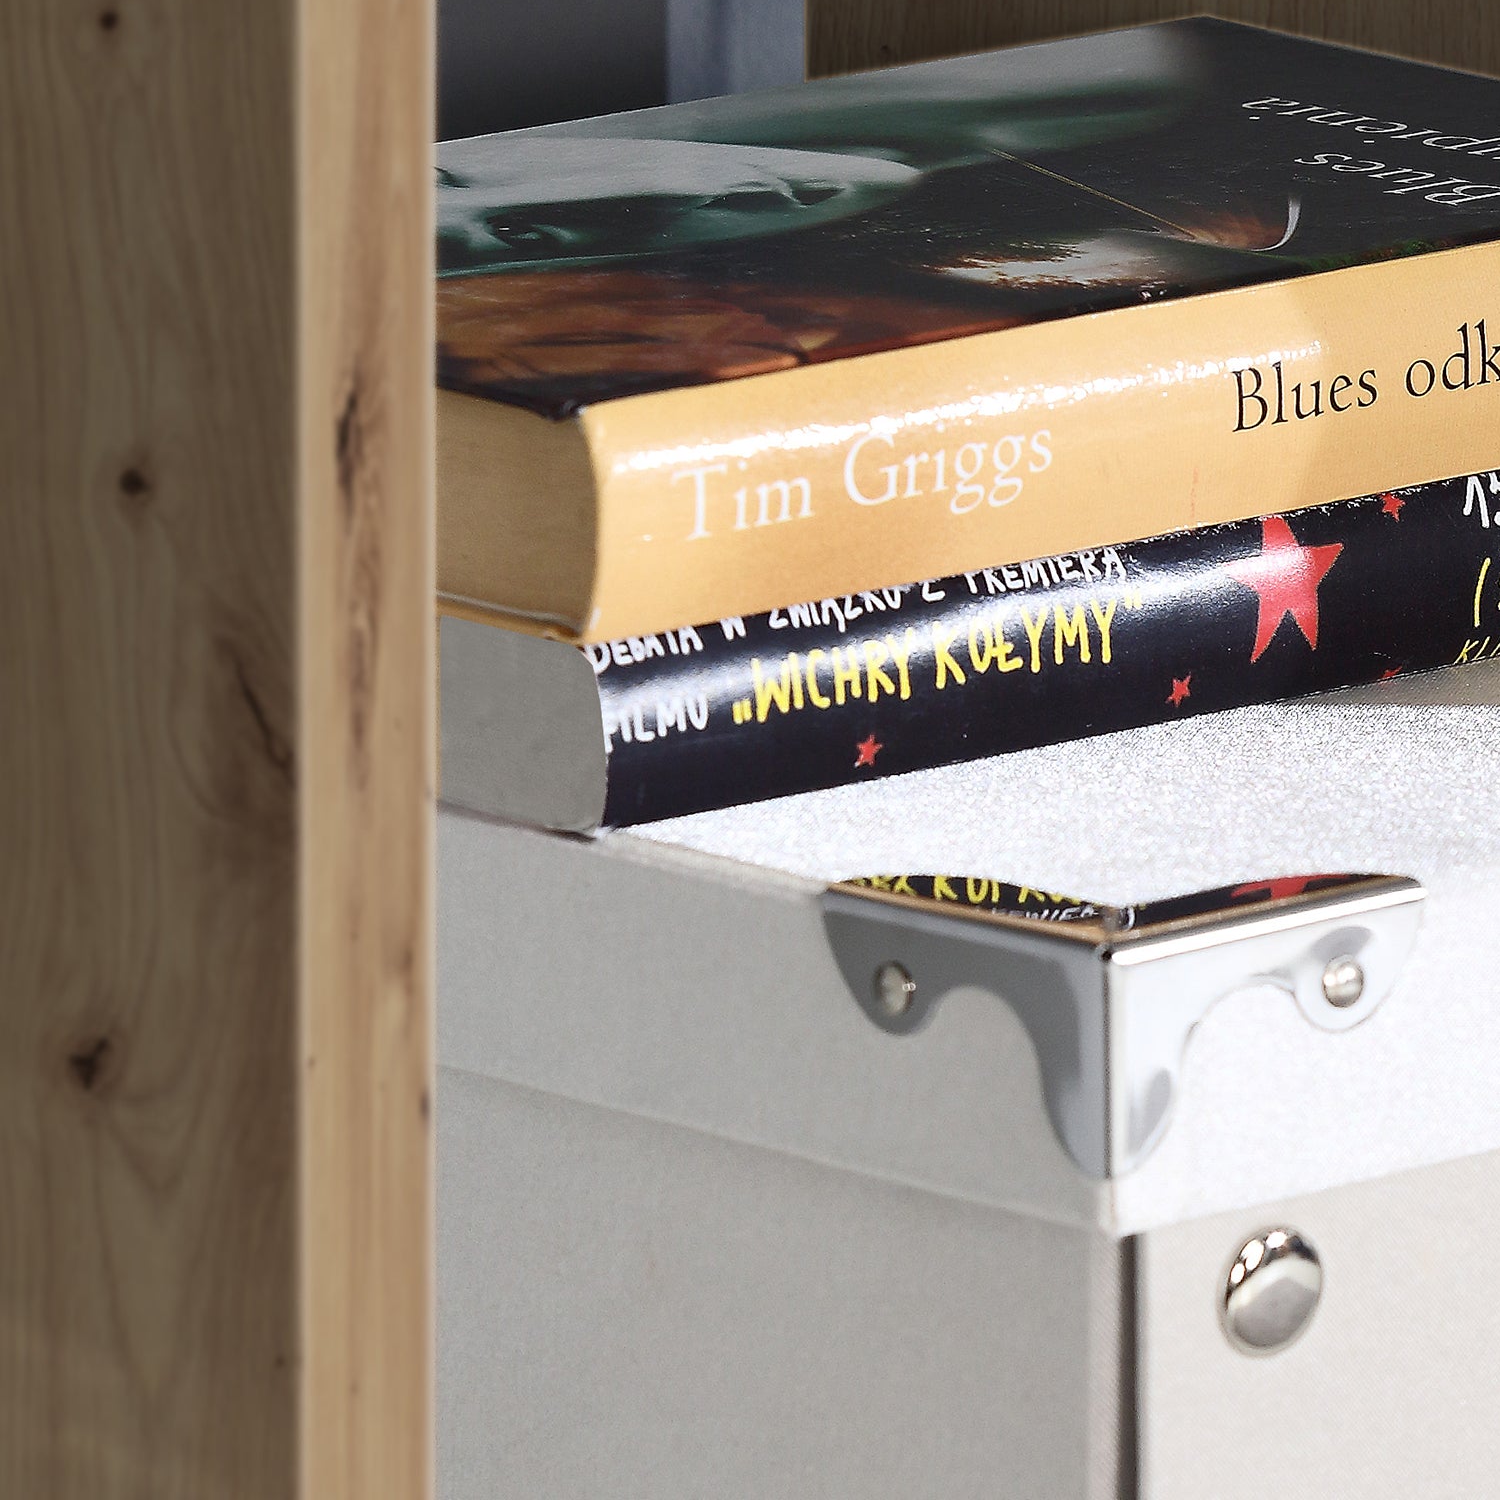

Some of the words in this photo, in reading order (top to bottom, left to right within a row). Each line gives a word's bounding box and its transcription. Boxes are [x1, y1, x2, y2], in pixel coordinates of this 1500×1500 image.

[671, 460, 816, 542] Tim
[843, 425, 1053, 515] Griggs
[1232, 361, 1378, 432] Blues
